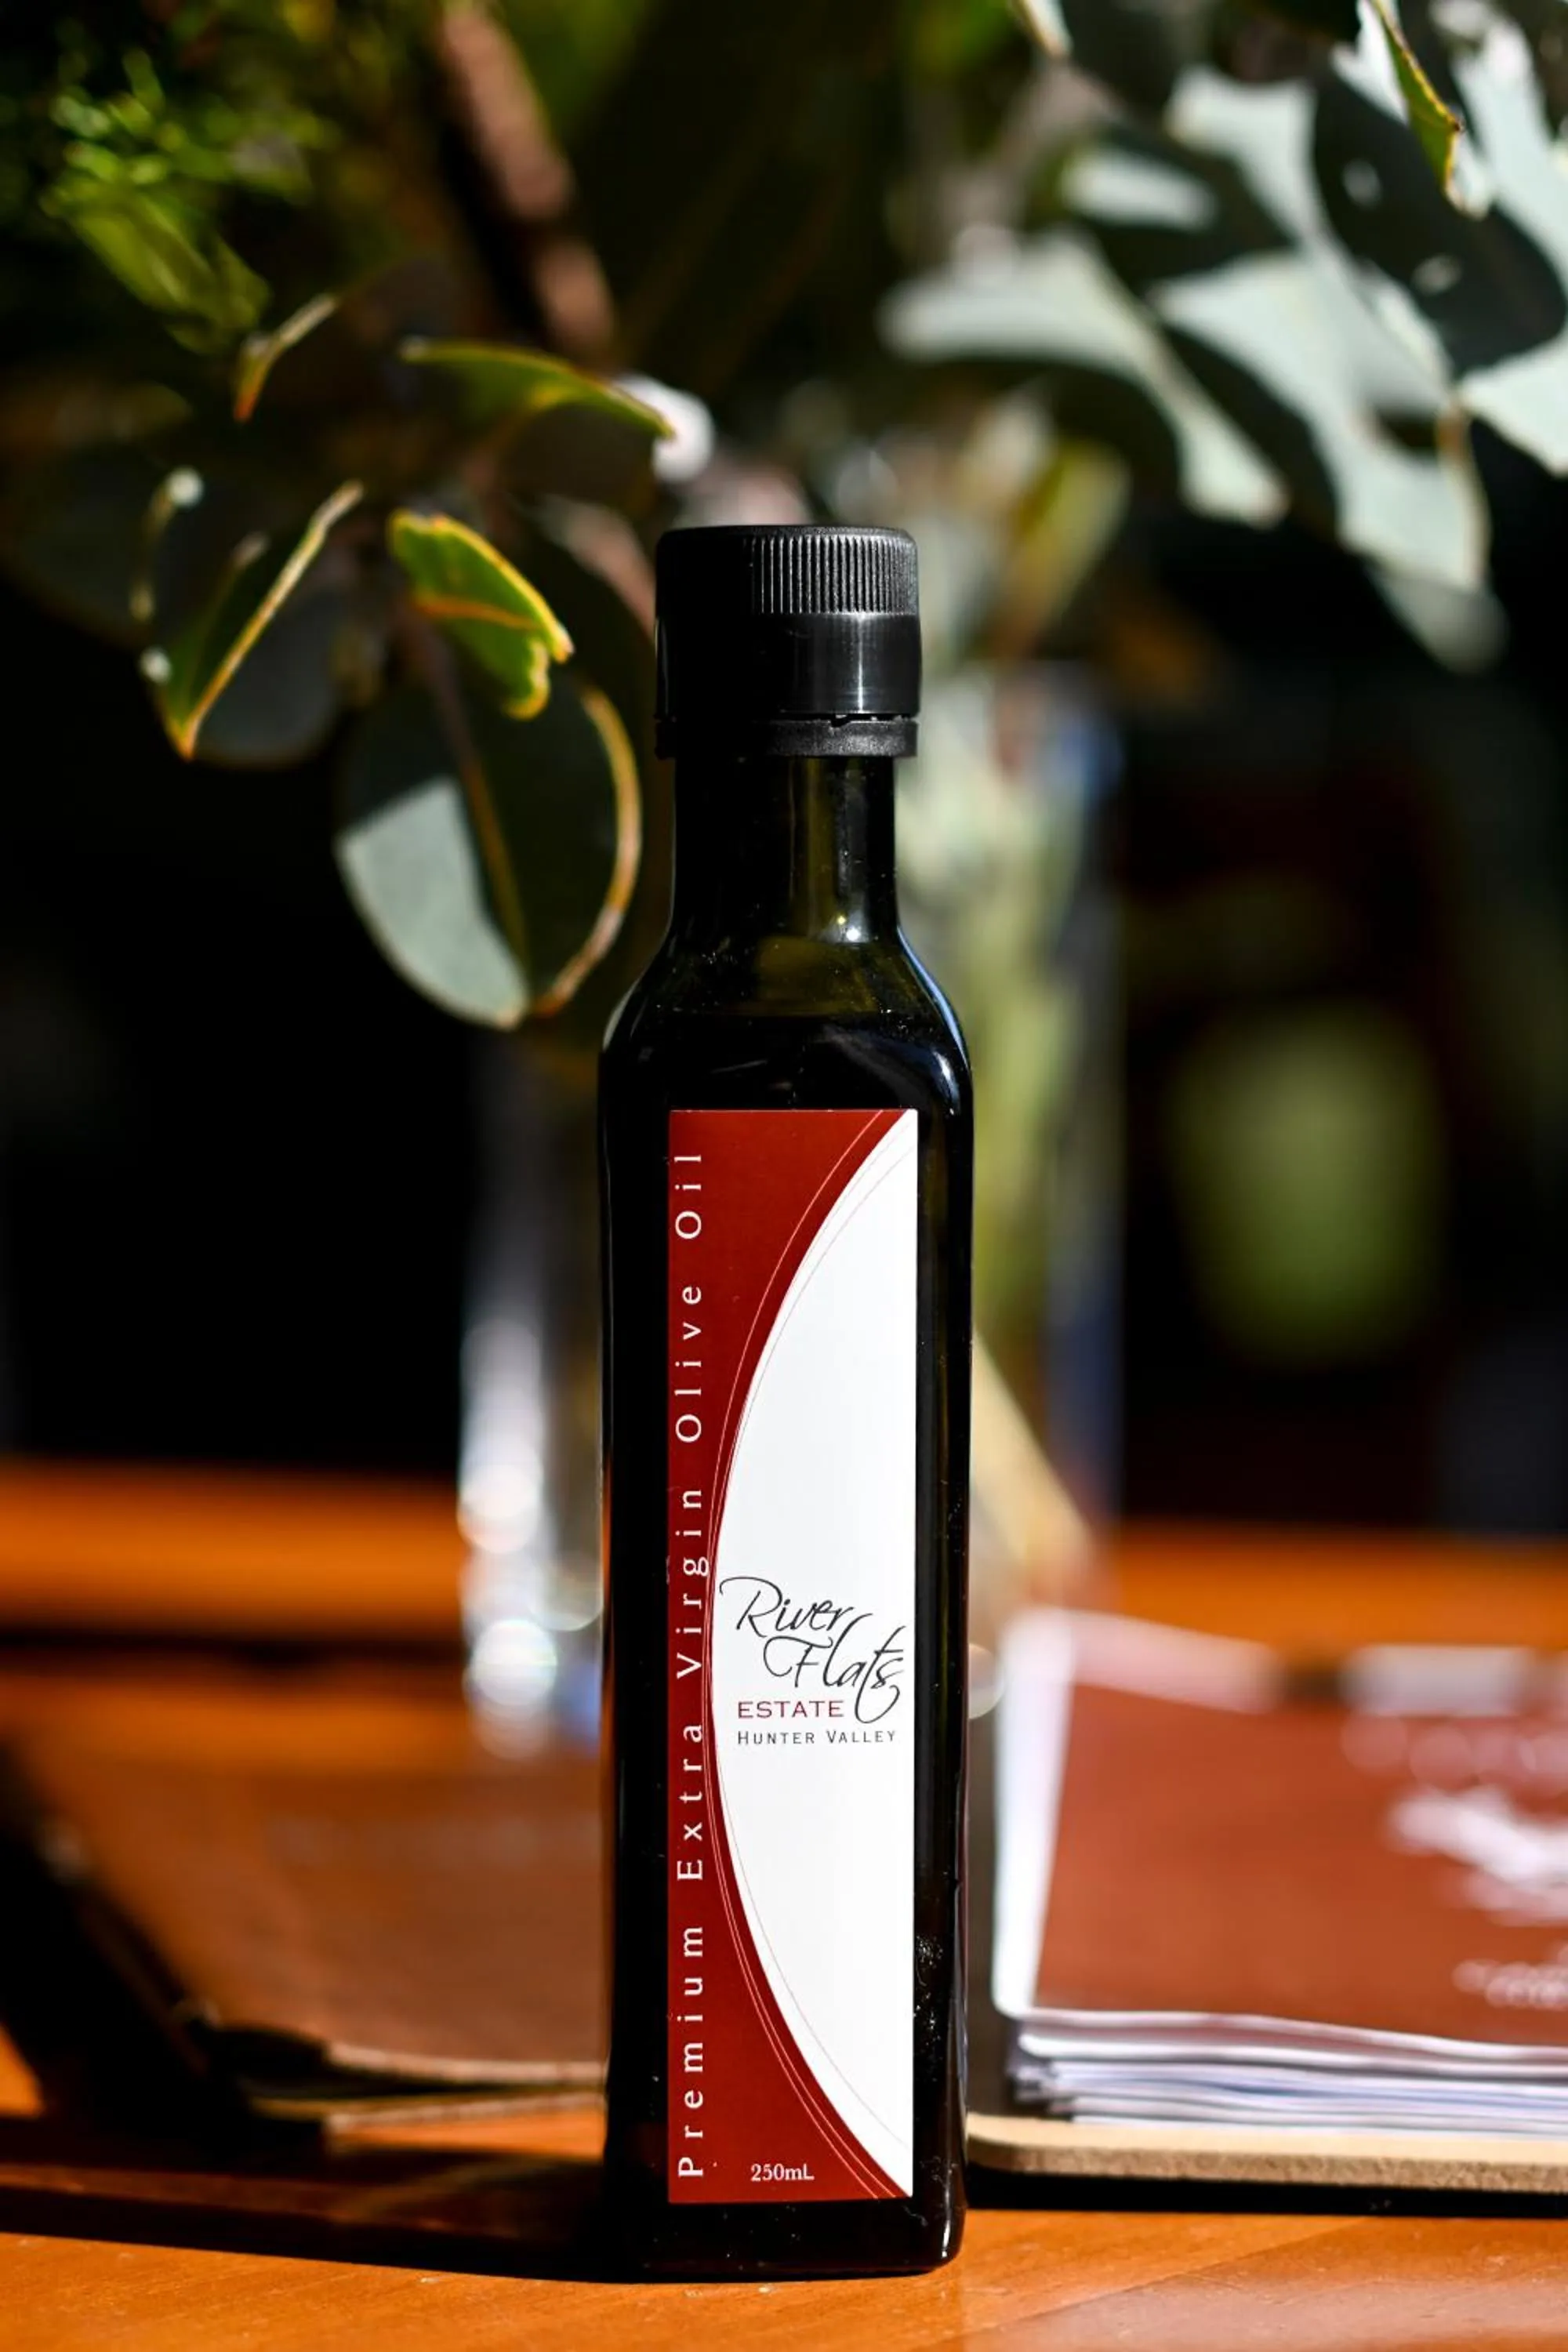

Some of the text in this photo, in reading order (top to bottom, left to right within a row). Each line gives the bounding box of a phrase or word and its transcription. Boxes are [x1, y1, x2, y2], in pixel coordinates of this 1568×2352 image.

[719, 1575, 855, 1639] River
[673, 1155, 709, 2177] Premium Extra Virgin Olive Oil
[763, 1612, 907, 1724] Flats
[737, 1700, 844, 1719] ESTATE
[737, 1730, 895, 1745] HUNTER VALLEY
[750, 2162, 815, 2182] 250mL
